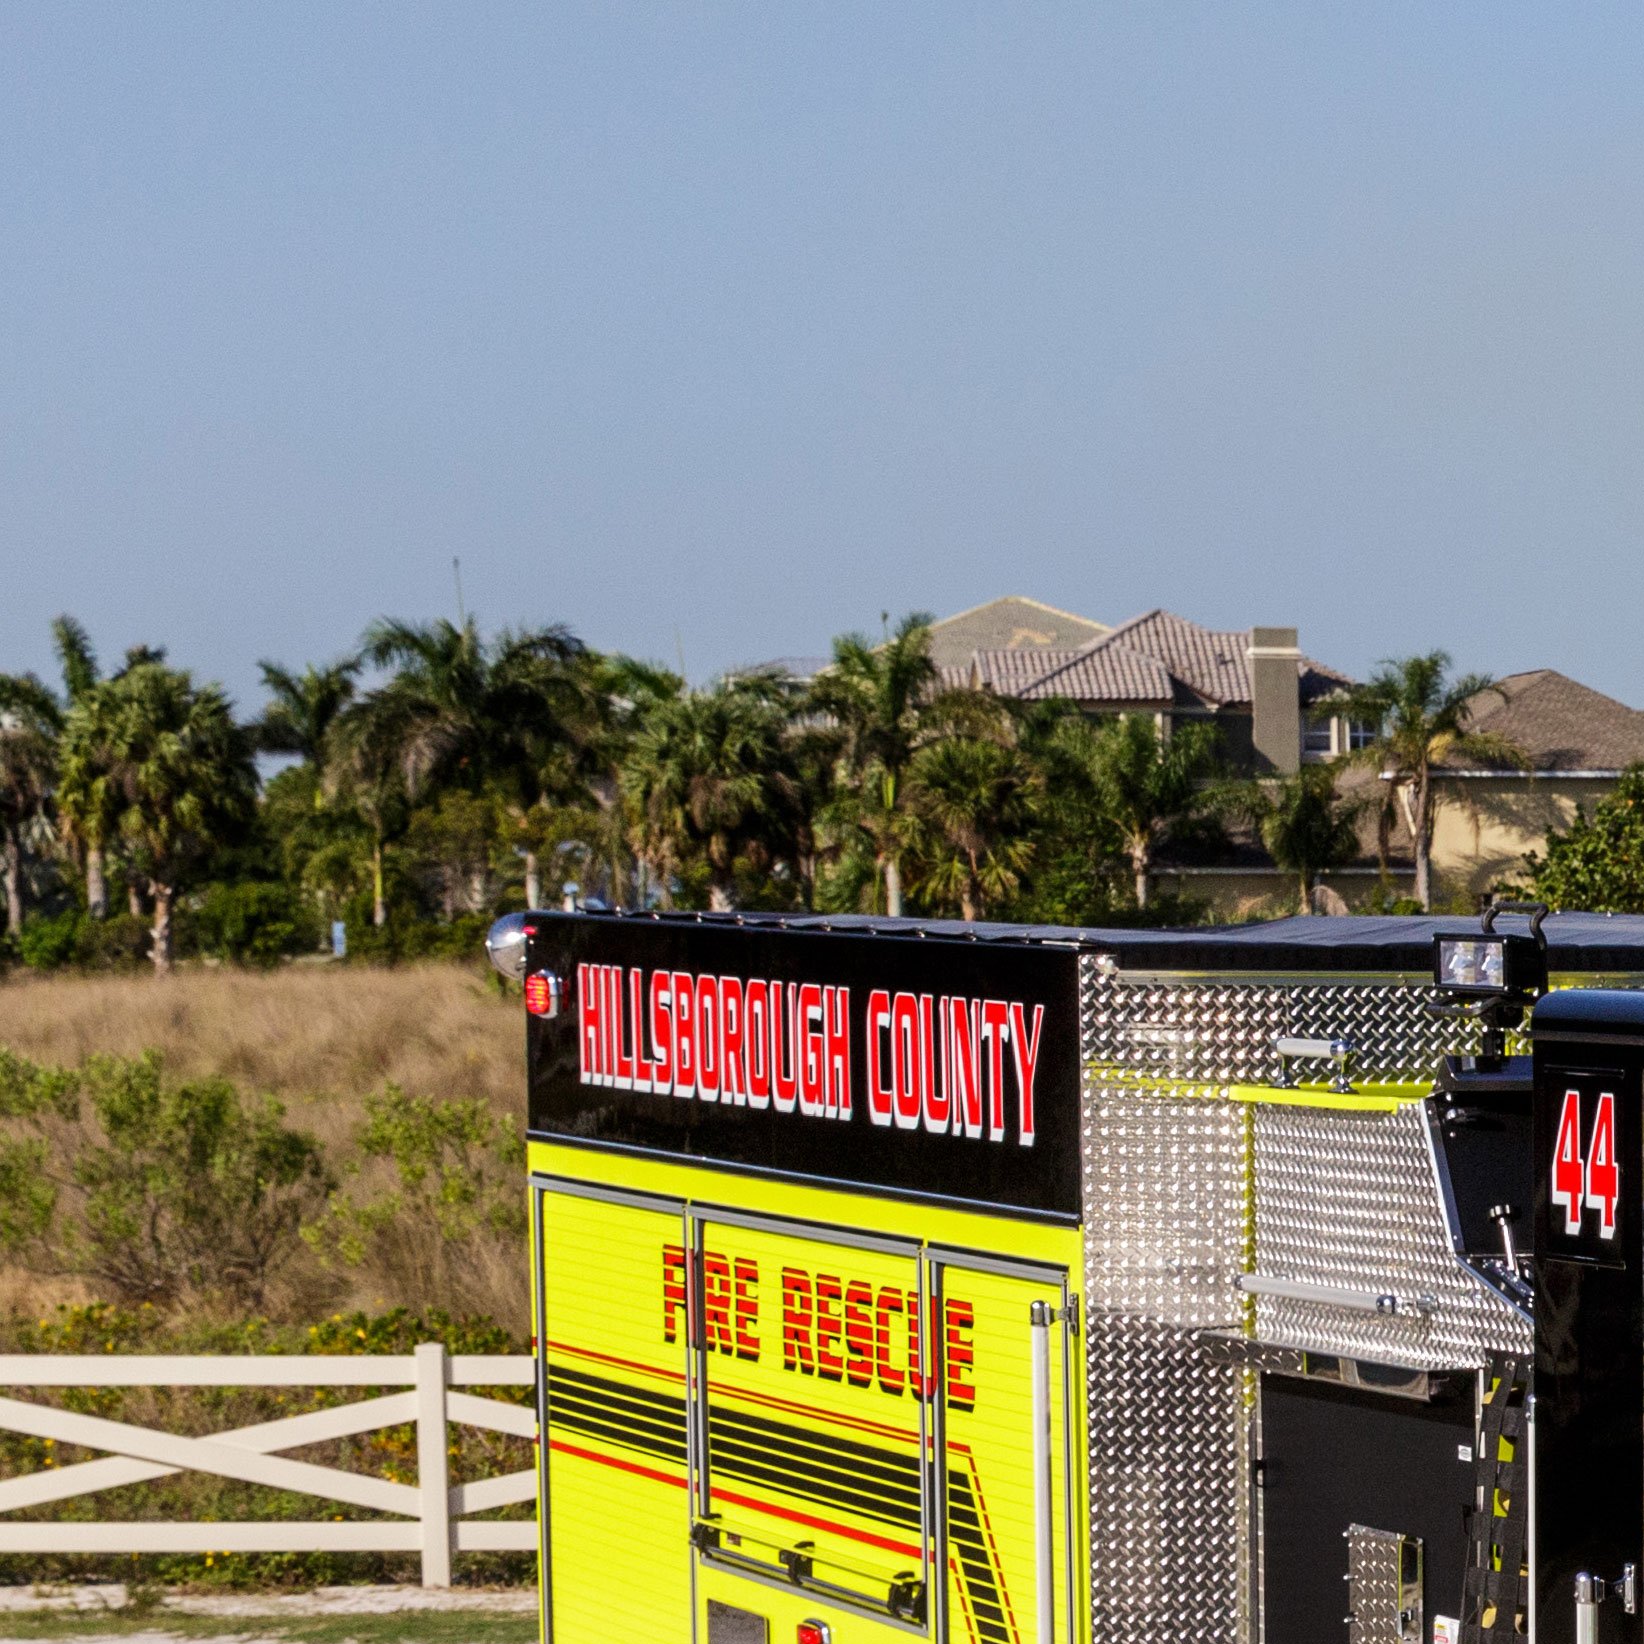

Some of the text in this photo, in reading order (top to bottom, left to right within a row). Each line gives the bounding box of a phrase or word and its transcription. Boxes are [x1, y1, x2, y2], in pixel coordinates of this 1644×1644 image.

[578, 963, 1044, 1147] HILLSBOROUGH COUNTY
[1552, 1090, 1618, 1239] 44
[663, 1244, 975, 1413] FIRE RESCUE
